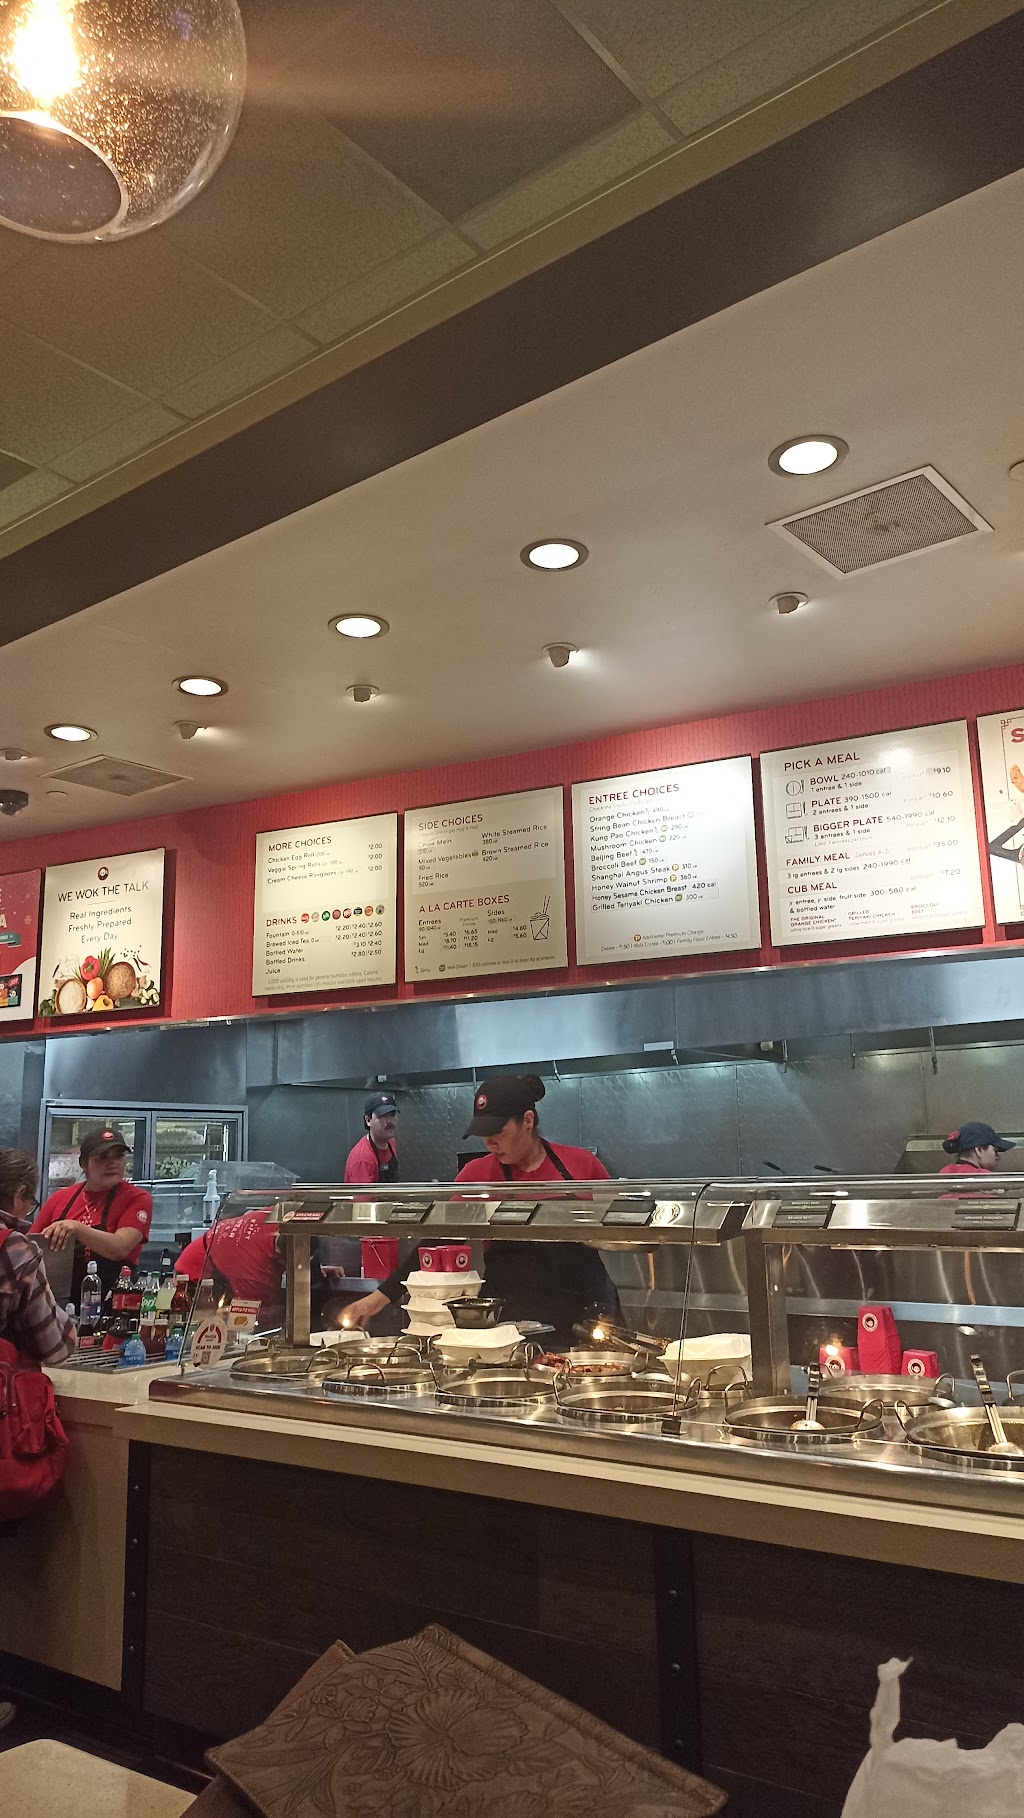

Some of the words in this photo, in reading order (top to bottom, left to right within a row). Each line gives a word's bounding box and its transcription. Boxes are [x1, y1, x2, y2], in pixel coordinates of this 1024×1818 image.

[784, 760, 812, 772] PICK
[815, 757, 824, 766] A
[827, 752, 860, 765] MEAL
[810, 774, 839, 786] BOWL
[841, 768, 875, 781] 240-1010
[589, 792, 629, 805] ENTREE
[632, 784, 680, 798] CHOICES
[816, 784, 836, 792] entree
[812, 797, 842, 808] PLATE
[844, 792, 880, 803] 390-1500
[590, 814, 615, 823] Orange
[617, 810, 645, 819] Chicken
[819, 806, 842, 814] entrees
[419, 821, 439, 831] SIDE
[442, 814, 483, 828] CHOICES
[590, 824, 611, 833] String
[613, 822, 630, 830] Bean
[632, 818, 661, 827] Chicken
[663, 813, 686, 822] Breast
[813, 821, 850, 832] BIGGER
[853, 816, 884, 826] PLATE
[886, 812, 922, 823] 540-1990
[482, 829, 500, 839] White
[503, 827, 531, 836] Steamed
[591, 835, 608, 843] Kung
[626, 828, 654, 837] Chicken
[821, 831, 844, 839] entrees
[268, 842, 292, 852] MORE
[295, 836, 332, 848] CHOICES
[482, 848, 502, 856] Brown
[504, 845, 532, 853] Steamed
[591, 842, 627, 852] Mushroom
[629, 838, 658, 847] Chicken
[268, 856, 290, 864] Chicken
[419, 856, 436, 864] Mixed
[438, 852, 472, 863] Vegetables
[591, 853, 614, 862] Beijing
[617, 850, 632, 858] Beef
[786, 856, 821, 867] FAMILY
[824, 852, 851, 863] MEAL
[591, 862, 619, 872] Broccoli
[621, 860, 637, 868] Beef
[800, 870, 823, 878] entrees
[863, 860, 899, 870] 240-1990
[287, 874, 307, 882] Cheese
[592, 872, 624, 882] Shanghai
[626, 869, 648, 878] Angus
[651, 866, 670, 874] Steak
[592, 883, 613, 891] Honey
[616, 880, 640, 888] Walnut
[643, 877, 668, 887] Shrimp
[788, 885, 808, 895] CUB
[811, 882, 838, 892] MEAL
[58, 892, 73, 903] WE
[76, 888, 99, 900] WOK
[102, 885, 120, 896] THE
[124, 881, 149, 892] TALK
[593, 893, 612, 902] Honey
[614, 890, 638, 899] Sesame
[640, 887, 665, 895] Chicken
[667, 884, 688, 893] Breast
[693, 882, 705, 890] 420
[871, 886, 904, 897] 300-580
[429, 904, 441, 912] LA
[444, 899, 474, 911] CARTE
[478, 895, 510, 907] BOXES
[593, 902, 615, 911] Grilled
[617, 899, 643, 908] Teriyaki
[645, 896, 674, 905] Chicken
[796, 905, 817, 913] bottled
[70, 912, 86, 920] Real
[89, 906, 131, 919] Ingredients
[68, 922, 94, 933] Freshly
[267, 917, 297, 927] DRINKS
[82, 935, 101, 944] Every
